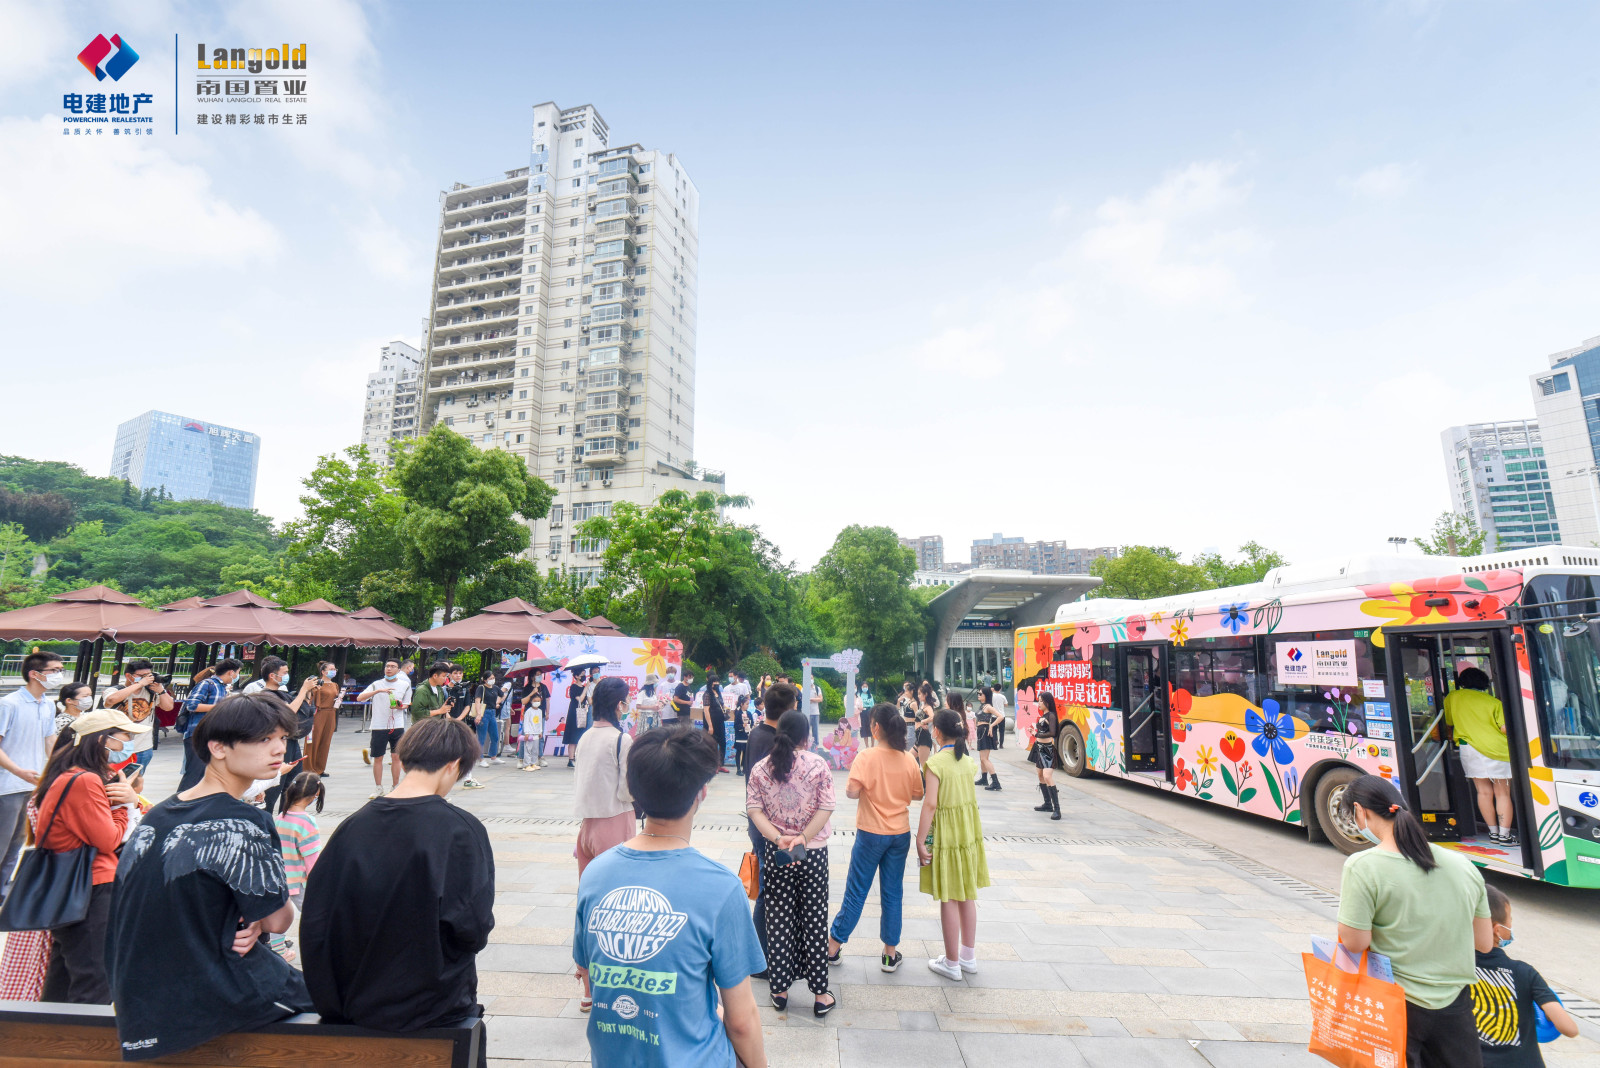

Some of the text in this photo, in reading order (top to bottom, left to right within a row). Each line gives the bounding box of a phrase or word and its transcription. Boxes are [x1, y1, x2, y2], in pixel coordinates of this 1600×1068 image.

[1316, 649, 1347, 659] Langold
[1049, 663, 1091, 679] 最想带妈妈
[1036, 681, 1109, 704] 去的地方是花店
[602, 889, 670, 914] WILLIAMSON
[589, 909, 685, 937] ESTABLISHED 1922
[598, 931, 665, 960] DICKIES
[592, 965, 673, 992] Dickies
[596, 1021, 659, 1046] FORT WORTH, TX
